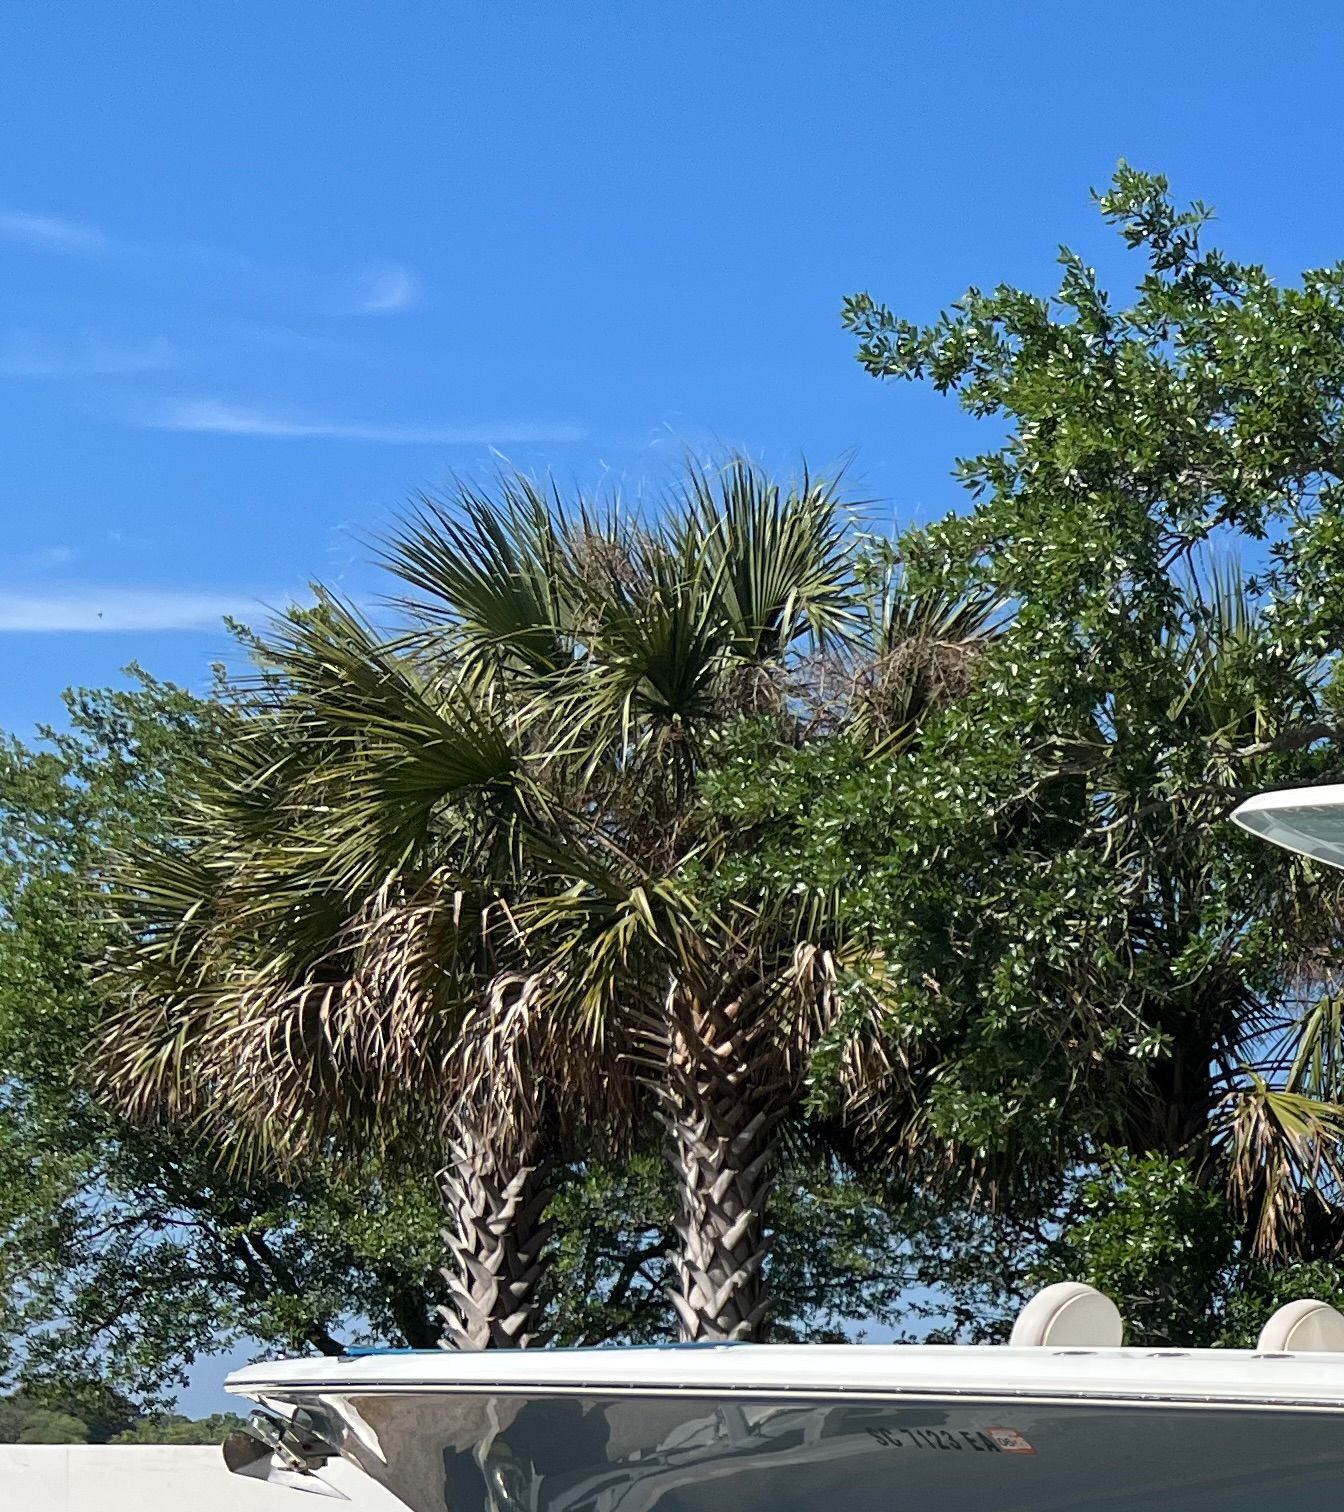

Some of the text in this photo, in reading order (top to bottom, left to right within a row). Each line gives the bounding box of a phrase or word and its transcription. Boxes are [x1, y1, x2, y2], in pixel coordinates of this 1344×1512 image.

[865, 1426, 1001, 1453] SC 7123 EA
